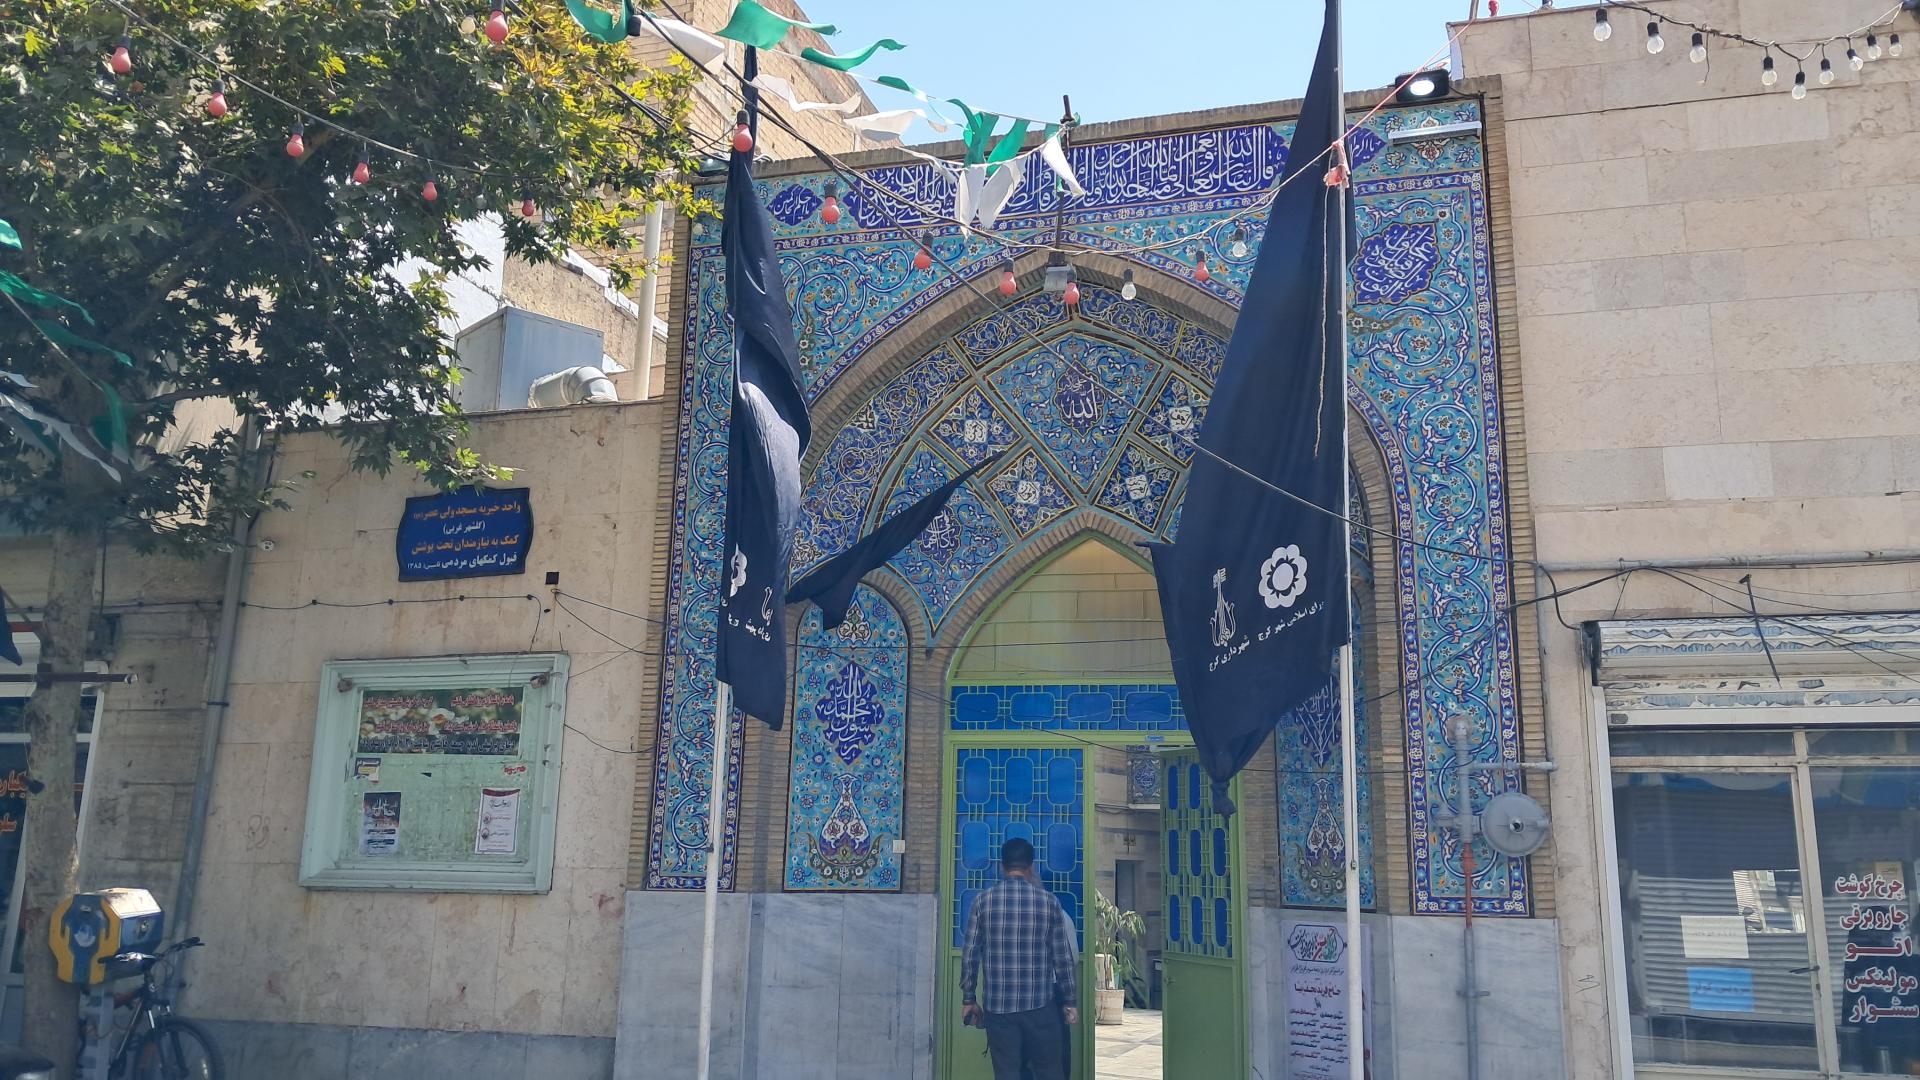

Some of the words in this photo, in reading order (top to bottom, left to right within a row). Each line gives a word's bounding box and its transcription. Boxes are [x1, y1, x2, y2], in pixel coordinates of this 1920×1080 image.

[453, 507, 478, 519] مسجد
[479, 505, 500, 516] خیریه
[502, 500, 521, 513] واحد
[437, 540, 453, 550] تحت
[454, 537, 489, 551] نیازمندان
[500, 534, 520, 545] کمک
[411, 543, 434, 556] پوشش
[442, 558, 467, 570] مردمی
[499, 552, 518, 566] قبول
[1286, 607, 1309, 628] اسلامی
[1257, 626, 1272, 642] کرج
[1273, 619, 1287, 634] شهر
[1221, 634, 1251, 664] شهرداری
[1208, 655, 1220, 672] کرج
[1835, 873, 1874, 899] گوشت
[1874, 874, 1905, 899] چرخ
[1840, 903, 1874, 930] برقی
[1875, 904, 1908, 930] جارو
[1845, 936, 1913, 961] اتو
[1849, 995, 1920, 1023] سشوار
